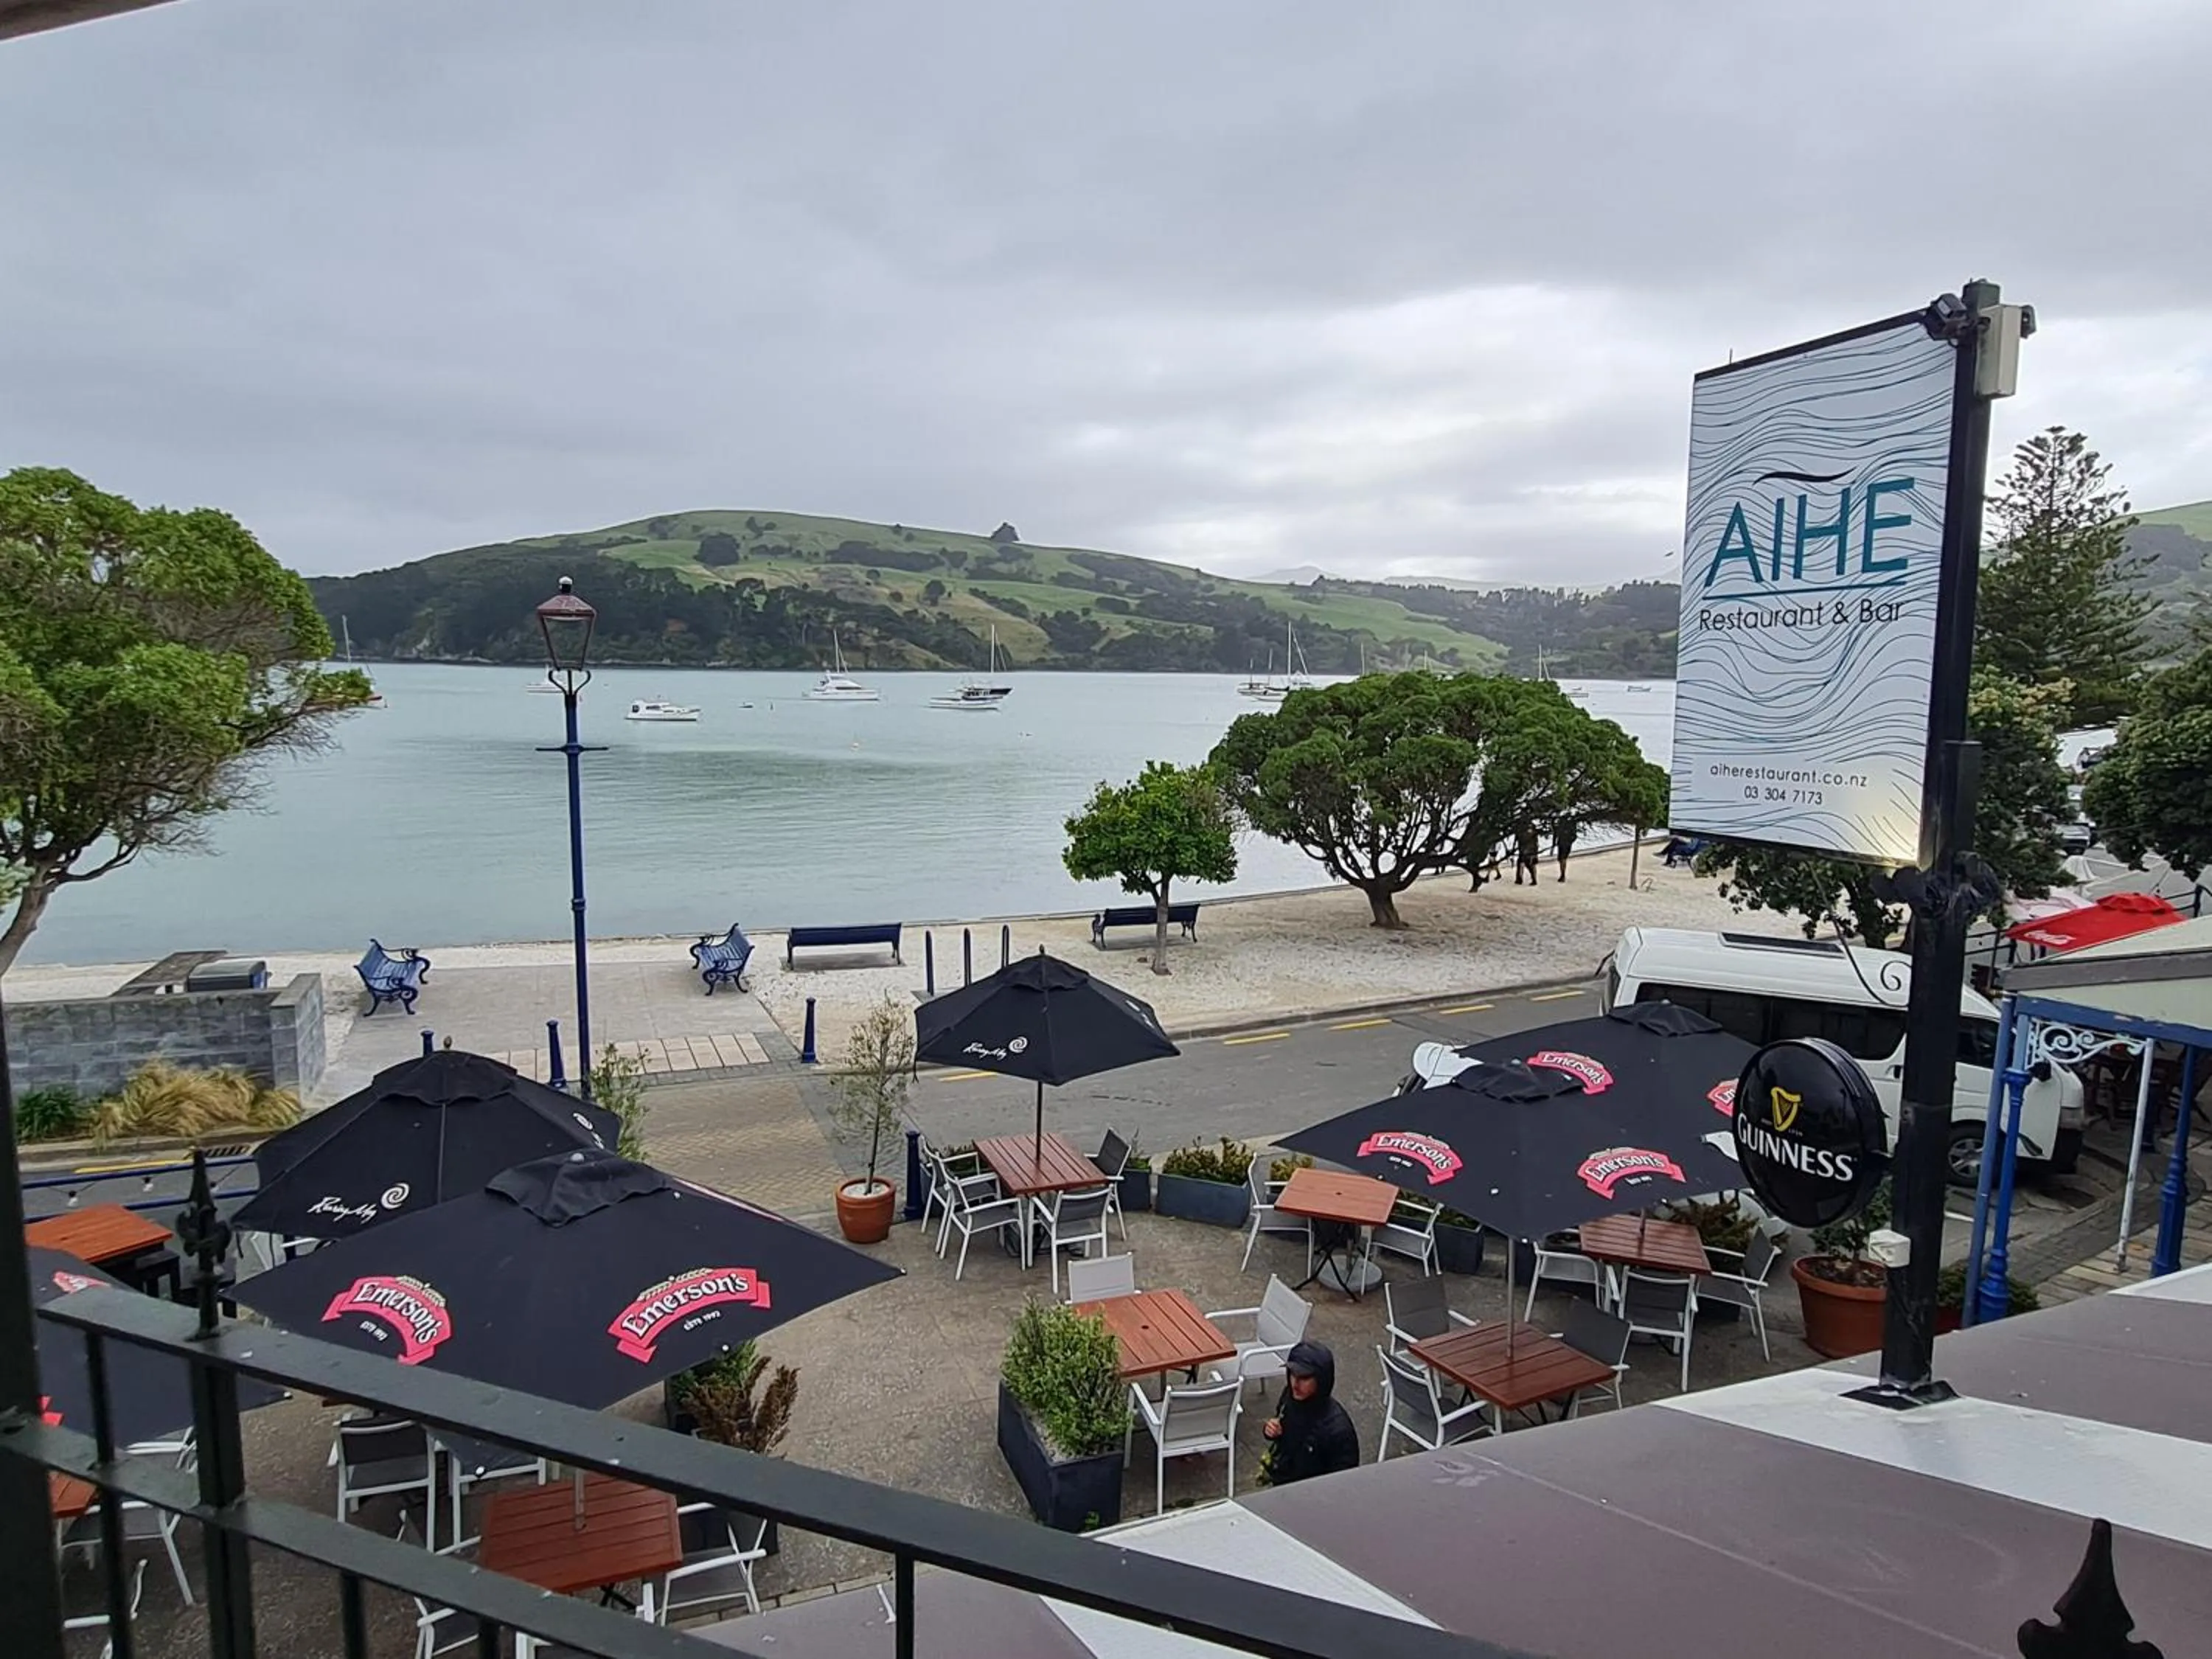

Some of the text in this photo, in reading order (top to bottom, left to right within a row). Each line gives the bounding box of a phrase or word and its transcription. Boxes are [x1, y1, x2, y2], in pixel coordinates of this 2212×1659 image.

[1703, 477, 1915, 588] AIHE
[1699, 598, 1905, 631] Restaurant & Bar
[1709, 763, 1868, 787] aiherestaurant.co.nz
[1744, 785, 1823, 805] 03 304 7173
[1377, 1135, 1453, 1169] Emerson's
[1737, 1112, 1854, 1182] GUINNESS
[1585, 1153, 1665, 1182] Emerson's
[352, 1281, 442, 1344] Emerson's
[621, 1272, 750, 1338] Emerson's
